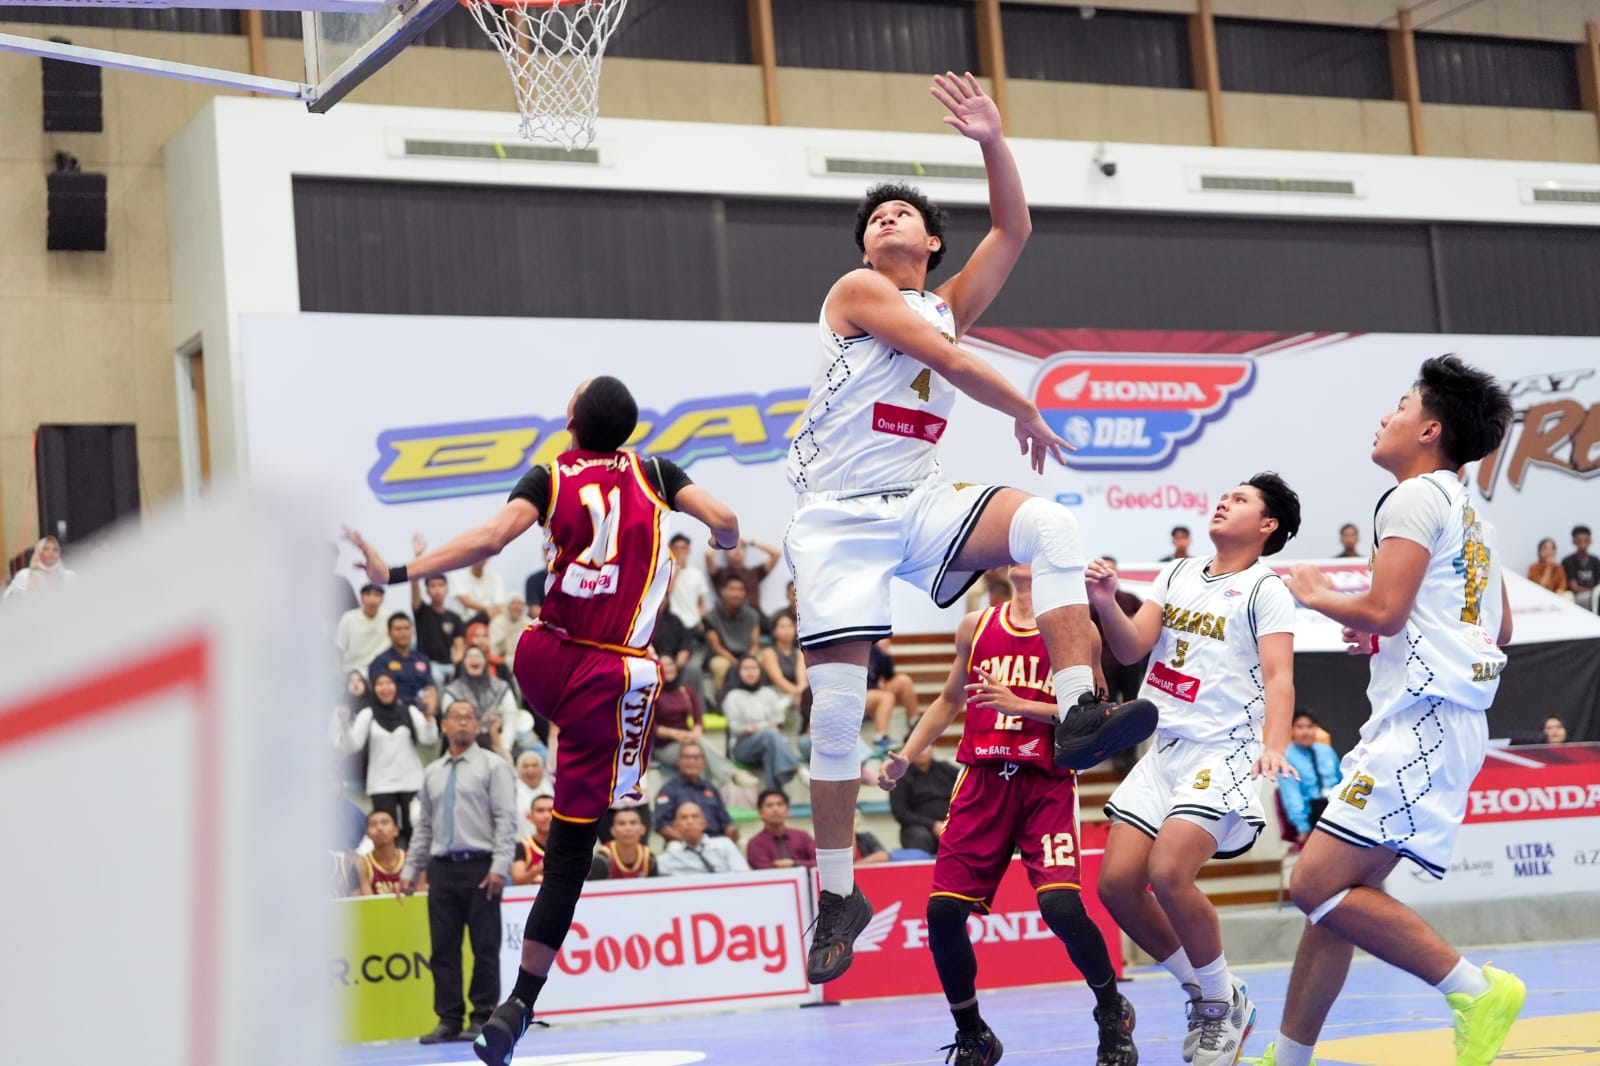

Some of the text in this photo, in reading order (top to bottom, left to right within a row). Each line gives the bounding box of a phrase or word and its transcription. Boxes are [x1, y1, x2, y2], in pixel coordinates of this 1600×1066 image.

[910, 368, 931, 402] 4
[1089, 381, 1207, 401] HONDA
[1501, 368, 1596, 398] AT
[878, 418, 896, 430] One
[1093, 416, 1151, 449] DBL
[576, 484, 620, 569] 11
[1171, 639, 1189, 668] 5
[975, 746, 988, 756] One
[1041, 832, 1075, 868] 12
[1506, 843, 1555, 860] ULTRA
[1514, 861, 1553, 877] MILK
